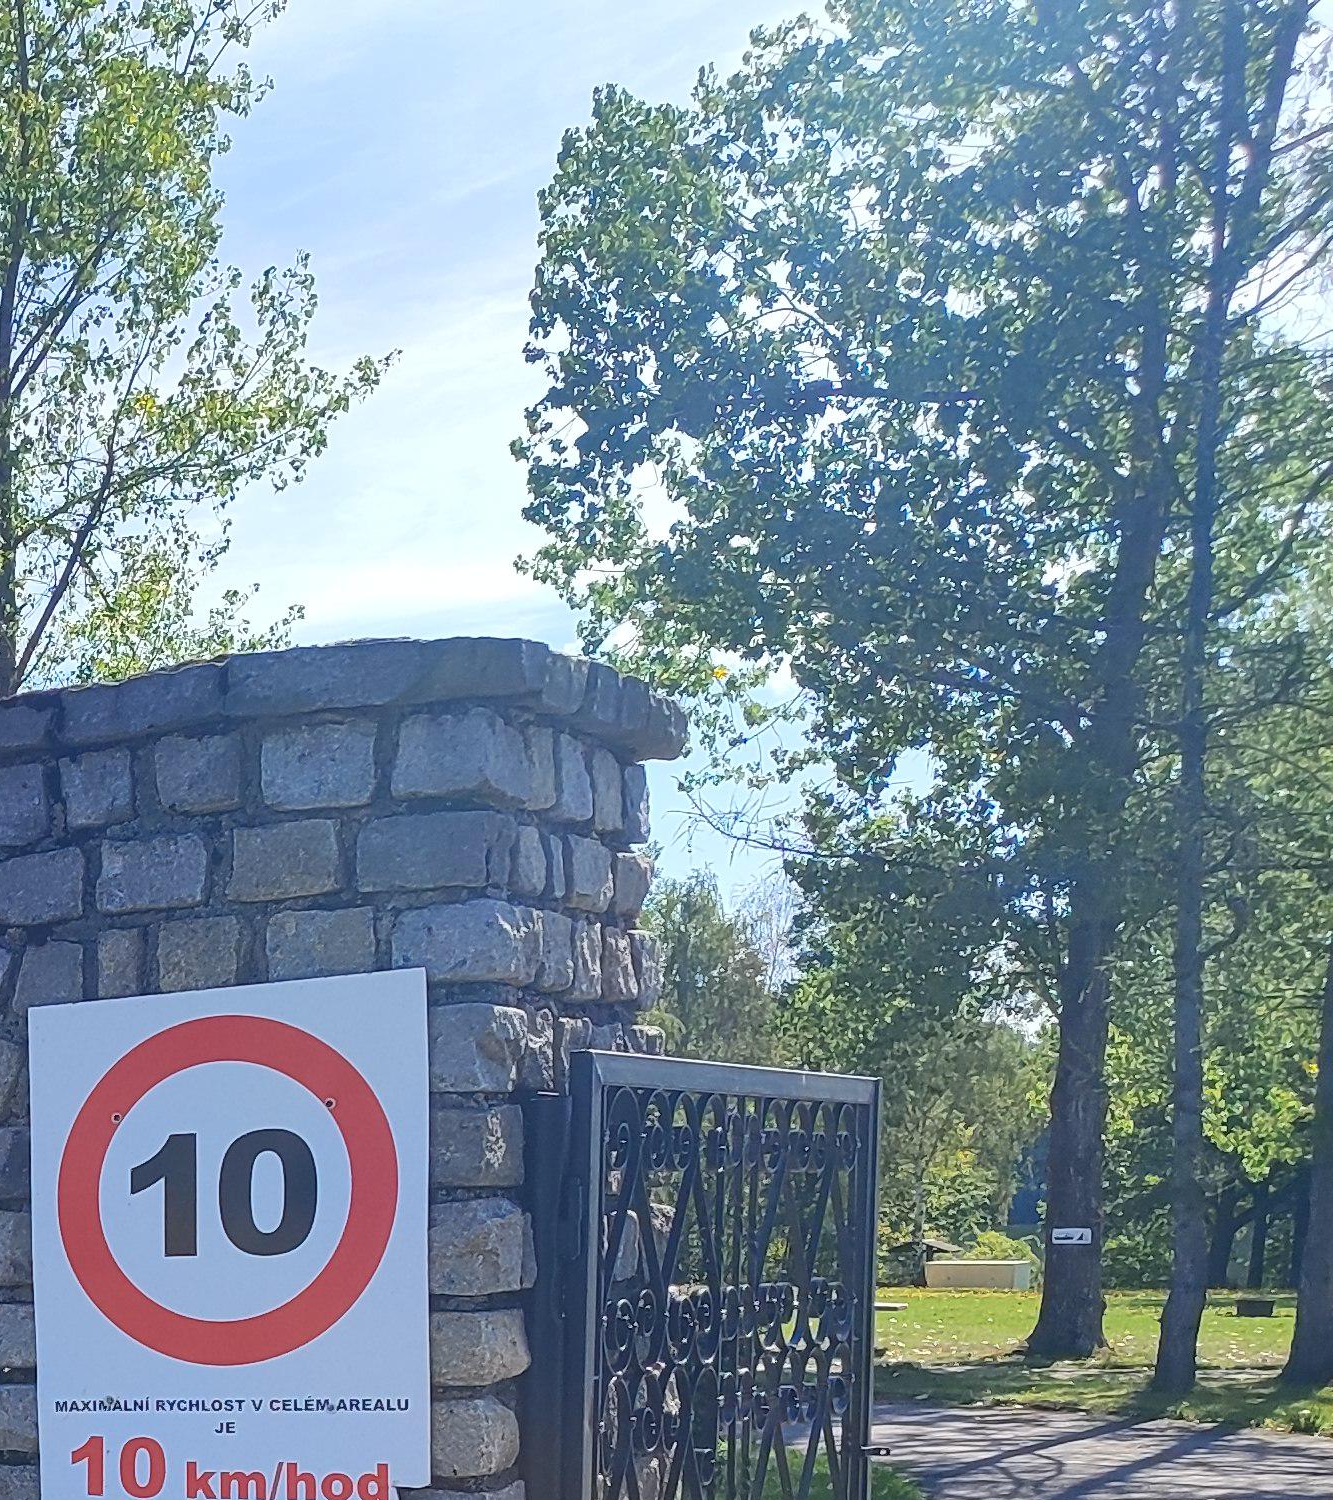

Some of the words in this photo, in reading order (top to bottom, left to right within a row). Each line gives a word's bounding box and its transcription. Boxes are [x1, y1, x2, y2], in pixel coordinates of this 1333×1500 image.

[130, 1128, 318, 1258] 10
[155, 1399, 245, 1412] RYCHLOST
[250, 1399, 263, 1412] V
[269, 1396, 331, 1412] CELÉM
[335, 1398, 410, 1412] AREALU
[214, 1421, 236, 1434] JE
[71, 1435, 167, 1499] 10
